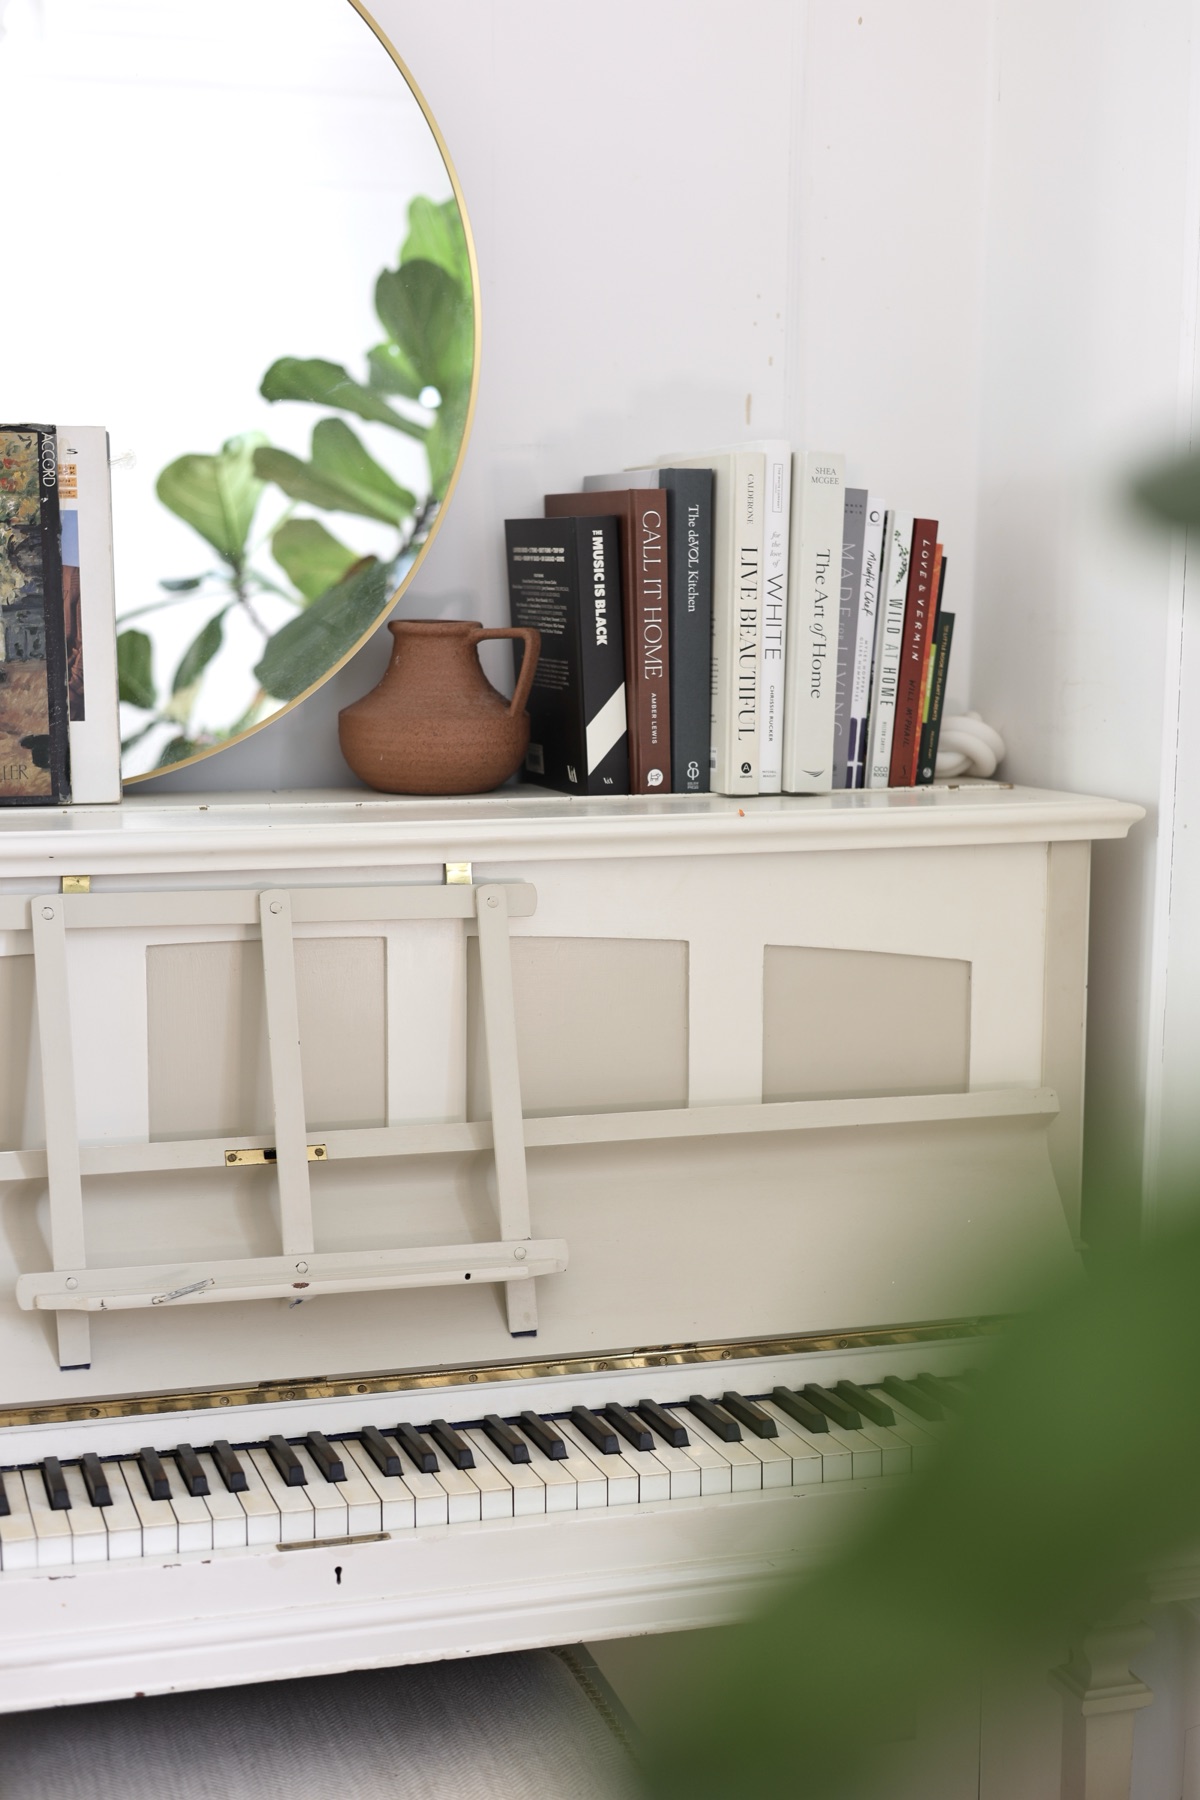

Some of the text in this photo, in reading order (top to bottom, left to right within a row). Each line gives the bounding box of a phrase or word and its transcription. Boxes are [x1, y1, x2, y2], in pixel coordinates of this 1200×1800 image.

[41, 432, 56, 487] ACCORD
[811, 476, 839, 485] MCGEE
[815, 467, 837, 476] SHEA
[746, 473, 754, 525] CALDERONE
[592, 537, 605, 581] MUSIC
[687, 504, 699, 612] The deVOL Kitchen
[771, 531, 781, 539] for
[771, 540, 781, 548] the
[594, 584, 606, 597] IS
[642, 510, 663, 680] CALL IT HOME
[839, 543, 856, 617] MADE
[861, 550, 877, 617] Mindful Chef
[911, 539, 931, 661] LOVE & VERMIN
[595, 600, 608, 646] BLACK
[738, 547, 758, 741] LIVE BEAUTIFUL
[764, 573, 784, 660] WHITE
[809, 549, 831, 699] The Art of Home
[880, 599, 903, 706] WILD AT HOME
[0, 764, 28, 780] LER
